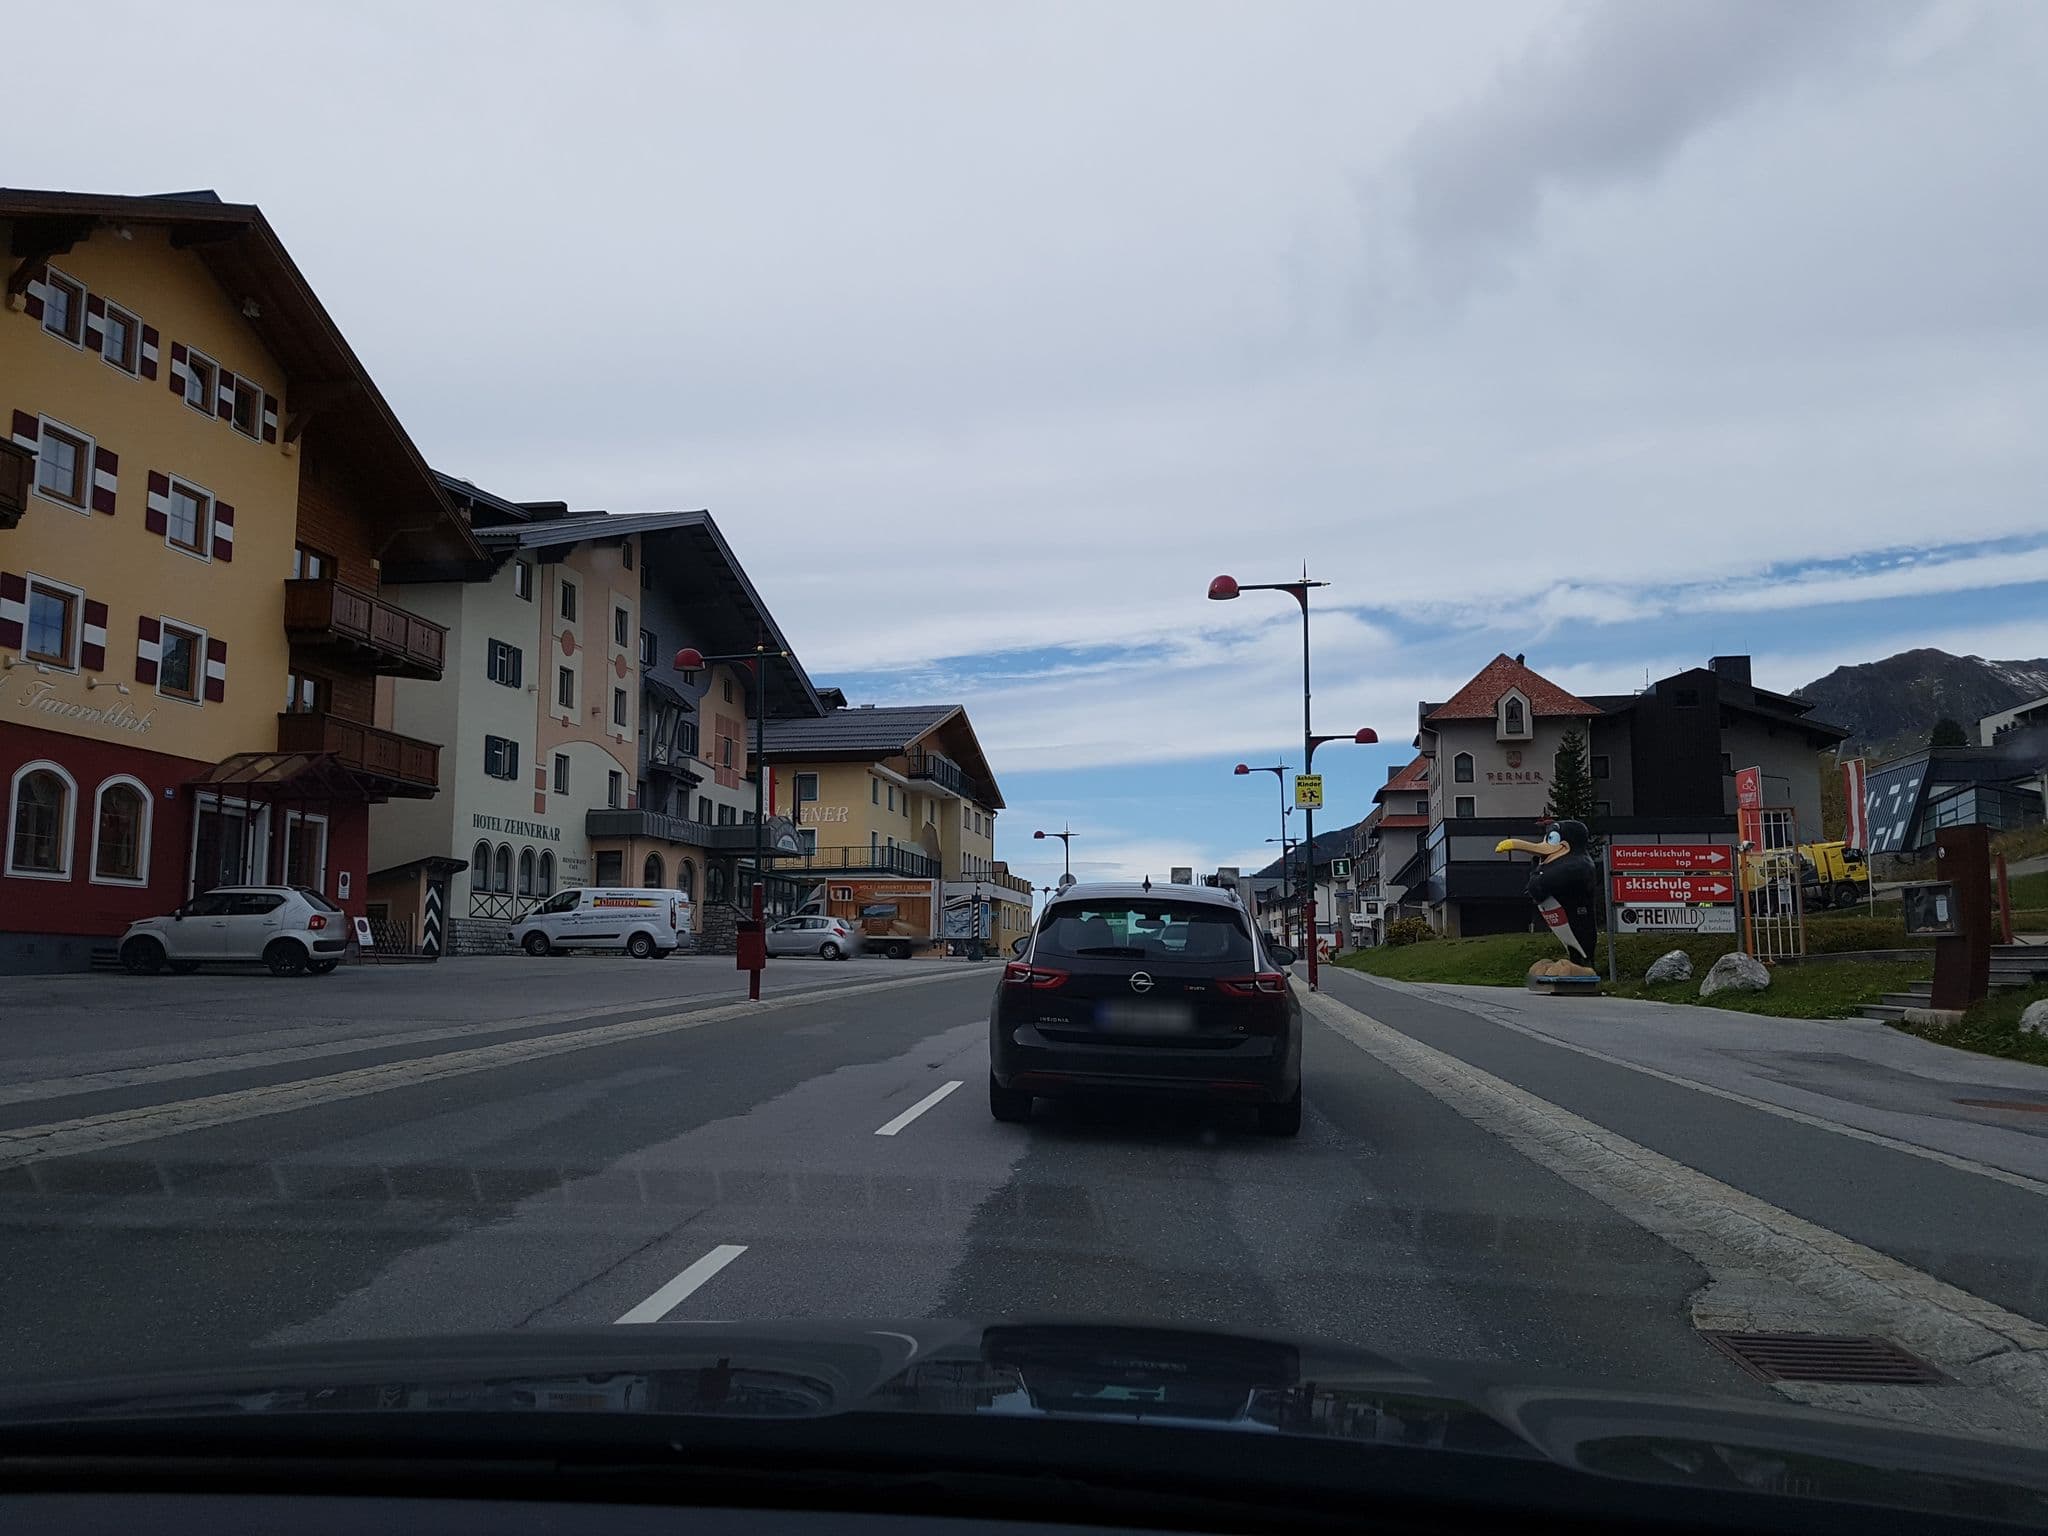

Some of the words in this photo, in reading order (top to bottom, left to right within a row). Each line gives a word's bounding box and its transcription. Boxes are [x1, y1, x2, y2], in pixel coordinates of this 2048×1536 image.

[472, 813, 503, 832] HOTEL
[504, 818, 561, 842] ZEHNERKAR
[1615, 849, 1692, 858] Kinder-skischule
[1675, 859, 1693, 869] top
[1625, 877, 1692, 891] skischule
[1669, 889, 1692, 902] top
[1635, 907, 1698, 927] FREIWILD
